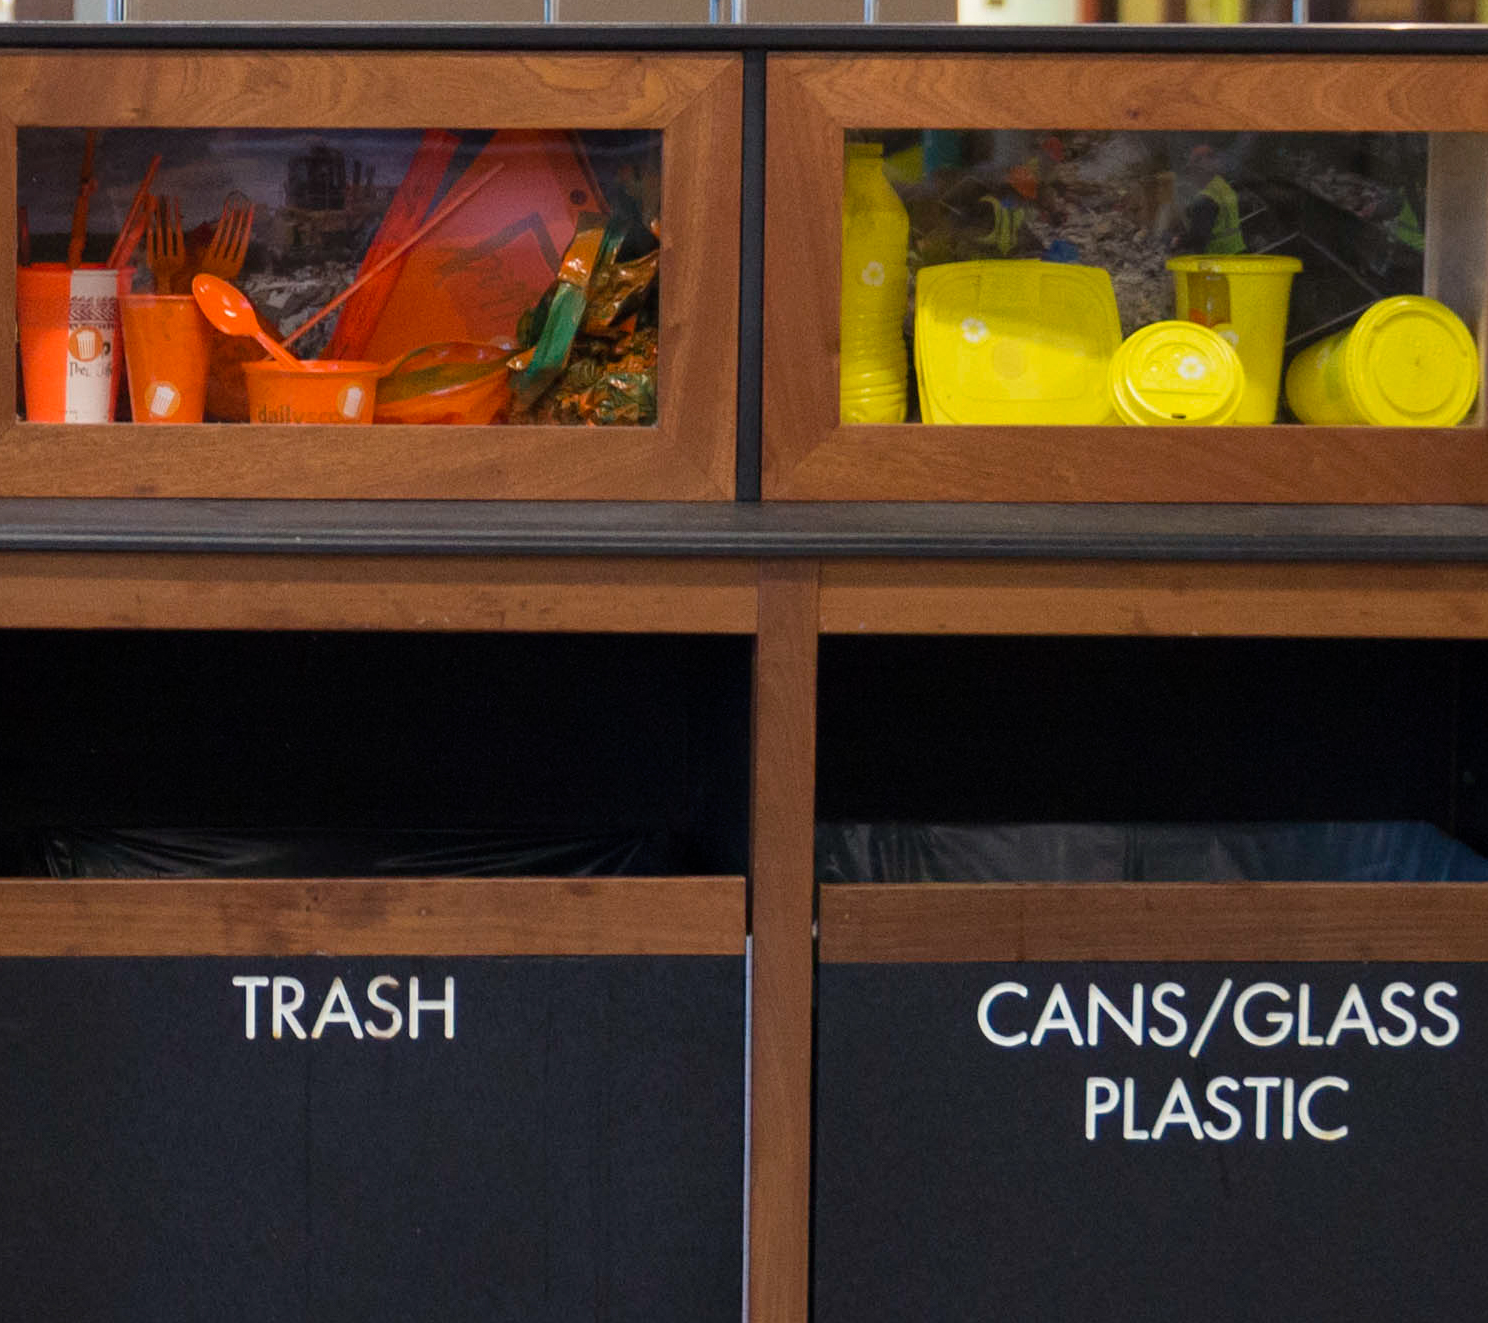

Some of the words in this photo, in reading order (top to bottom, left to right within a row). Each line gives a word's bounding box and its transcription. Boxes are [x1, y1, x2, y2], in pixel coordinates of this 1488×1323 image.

[232, 975, 456, 1040] TRASH
[977, 978, 1461, 1058] CANS/GLASS
[1085, 1076, 1350, 1141] PLASTIC
